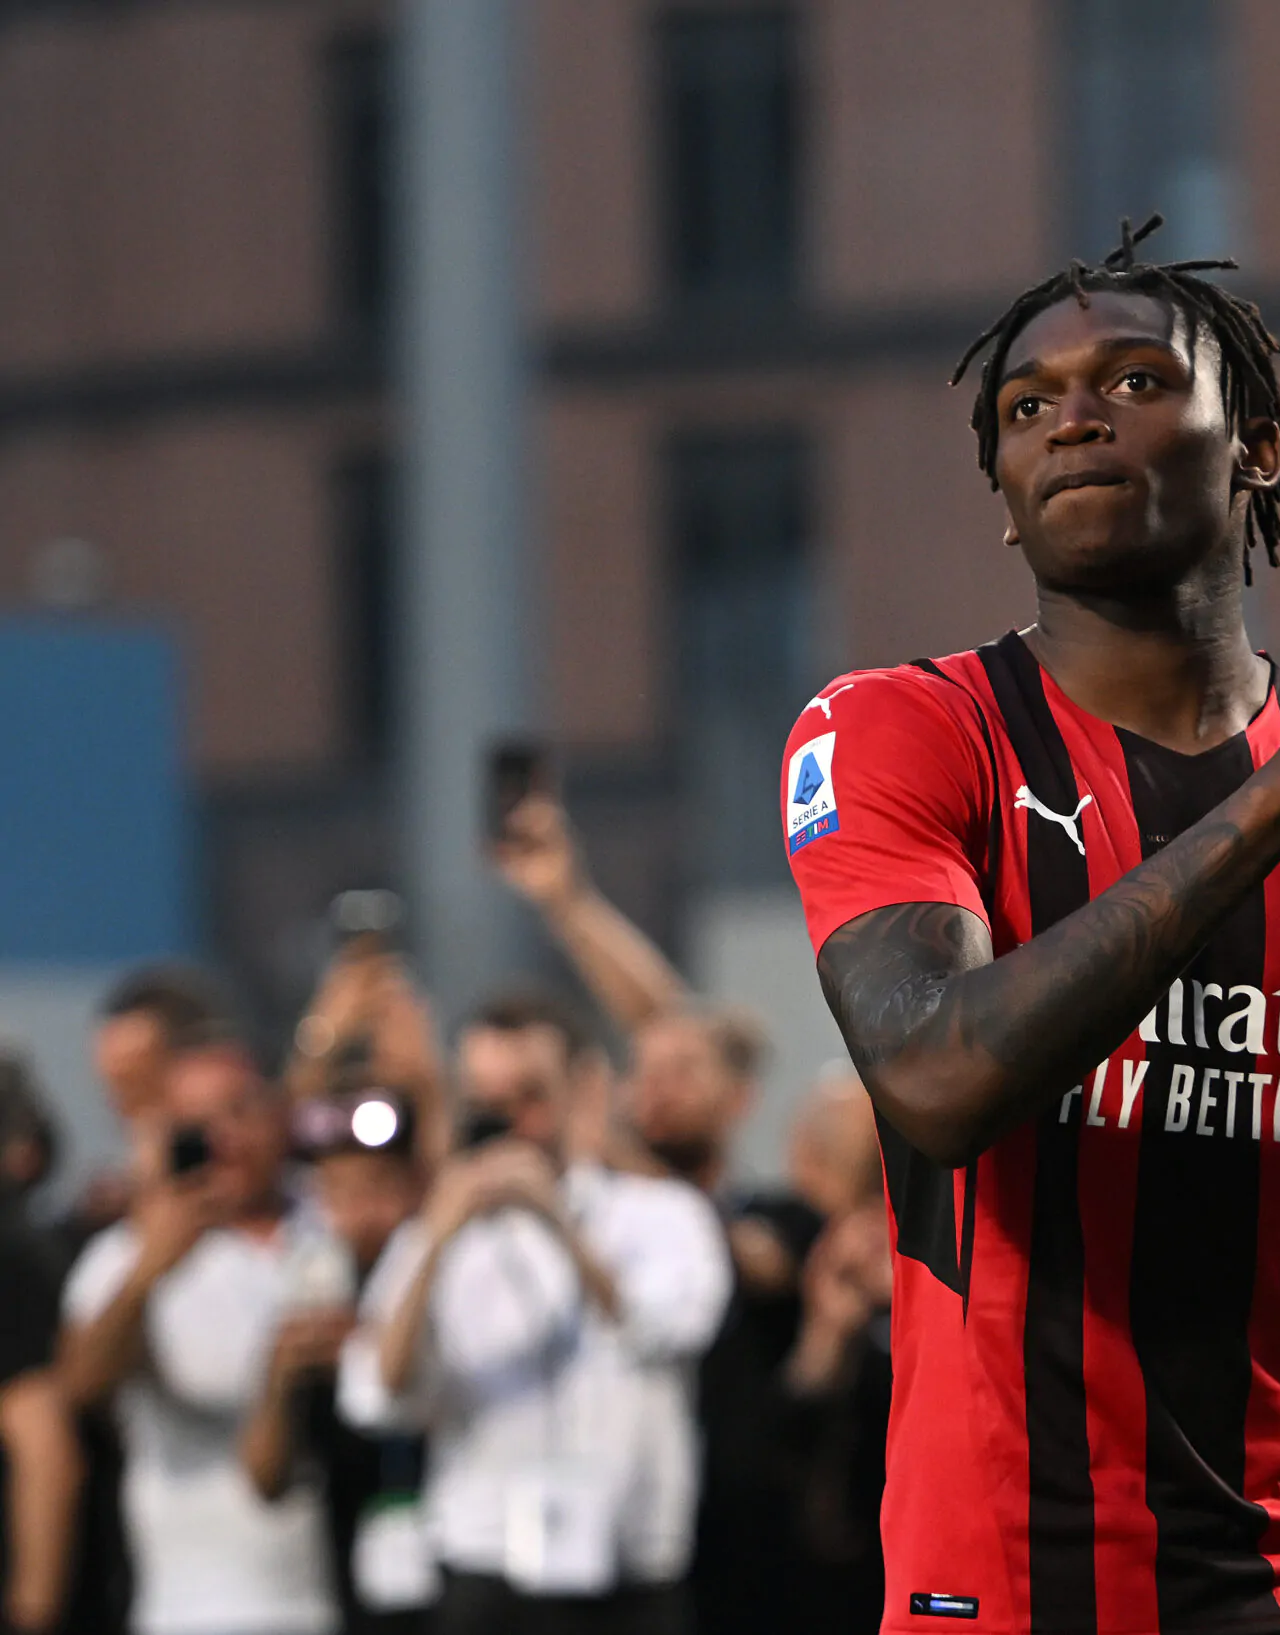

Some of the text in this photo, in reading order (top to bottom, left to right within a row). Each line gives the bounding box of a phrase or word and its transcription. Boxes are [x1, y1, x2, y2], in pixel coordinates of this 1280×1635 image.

[792, 800, 828, 829] SERIE A
[807, 818, 829, 837] TIM
